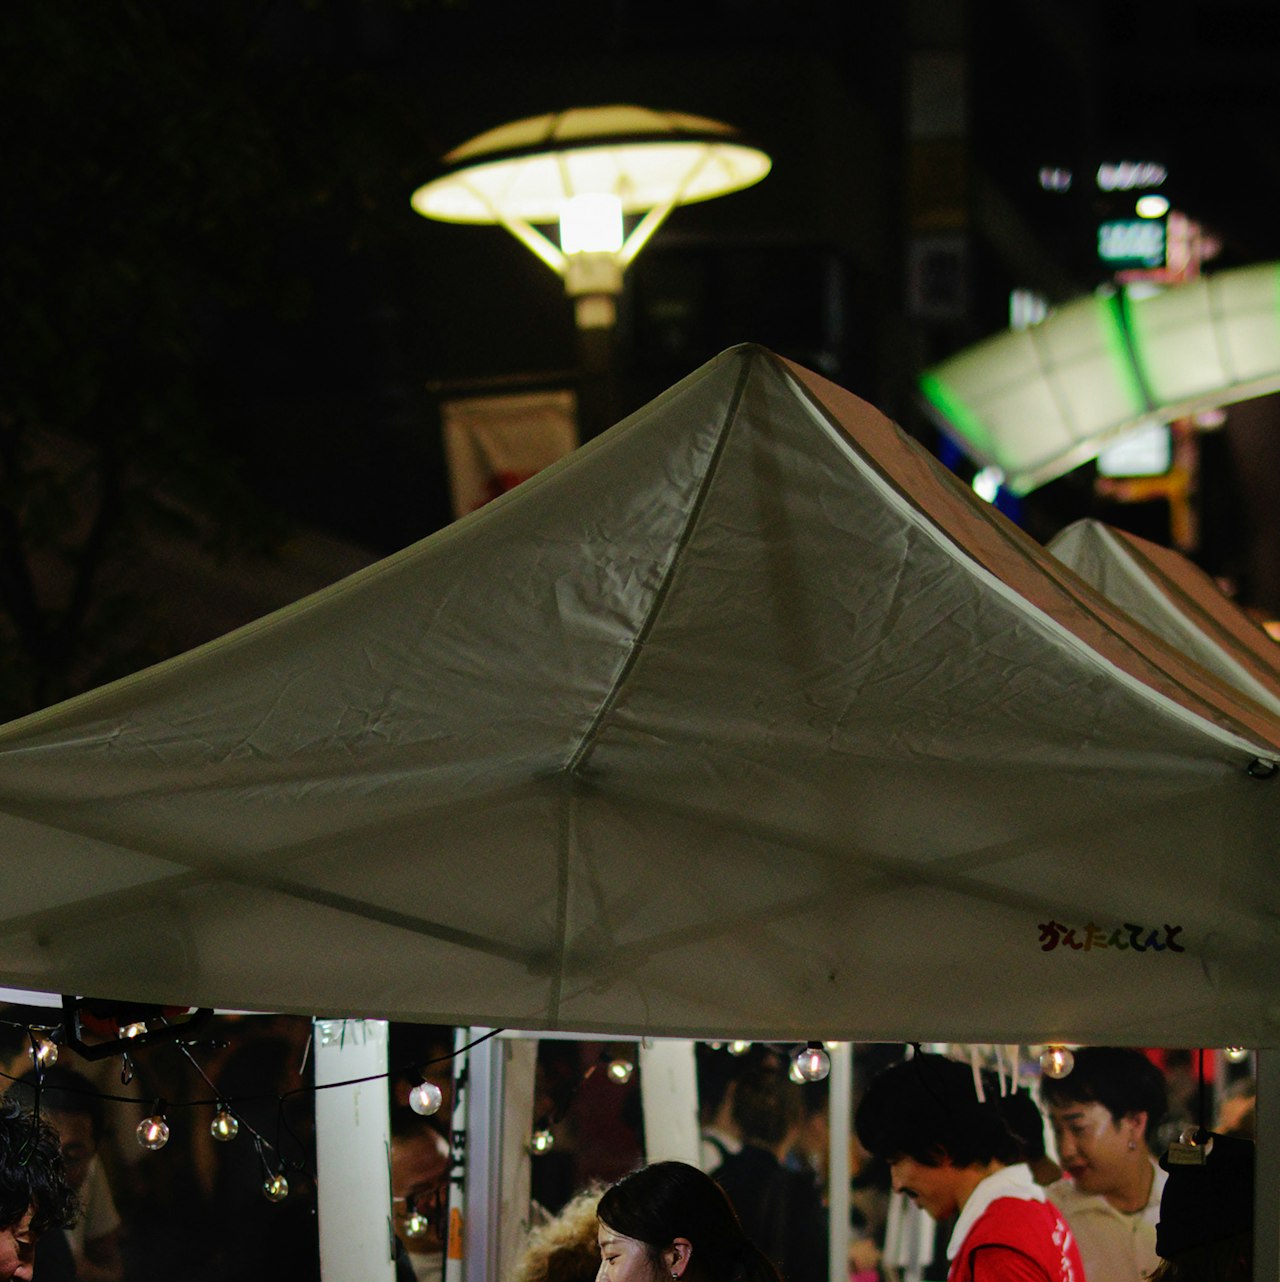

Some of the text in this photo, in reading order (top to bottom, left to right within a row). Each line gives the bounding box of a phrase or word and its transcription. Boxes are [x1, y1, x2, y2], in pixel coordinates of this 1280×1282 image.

[1038, 920, 1185, 952] かんたんてんと
